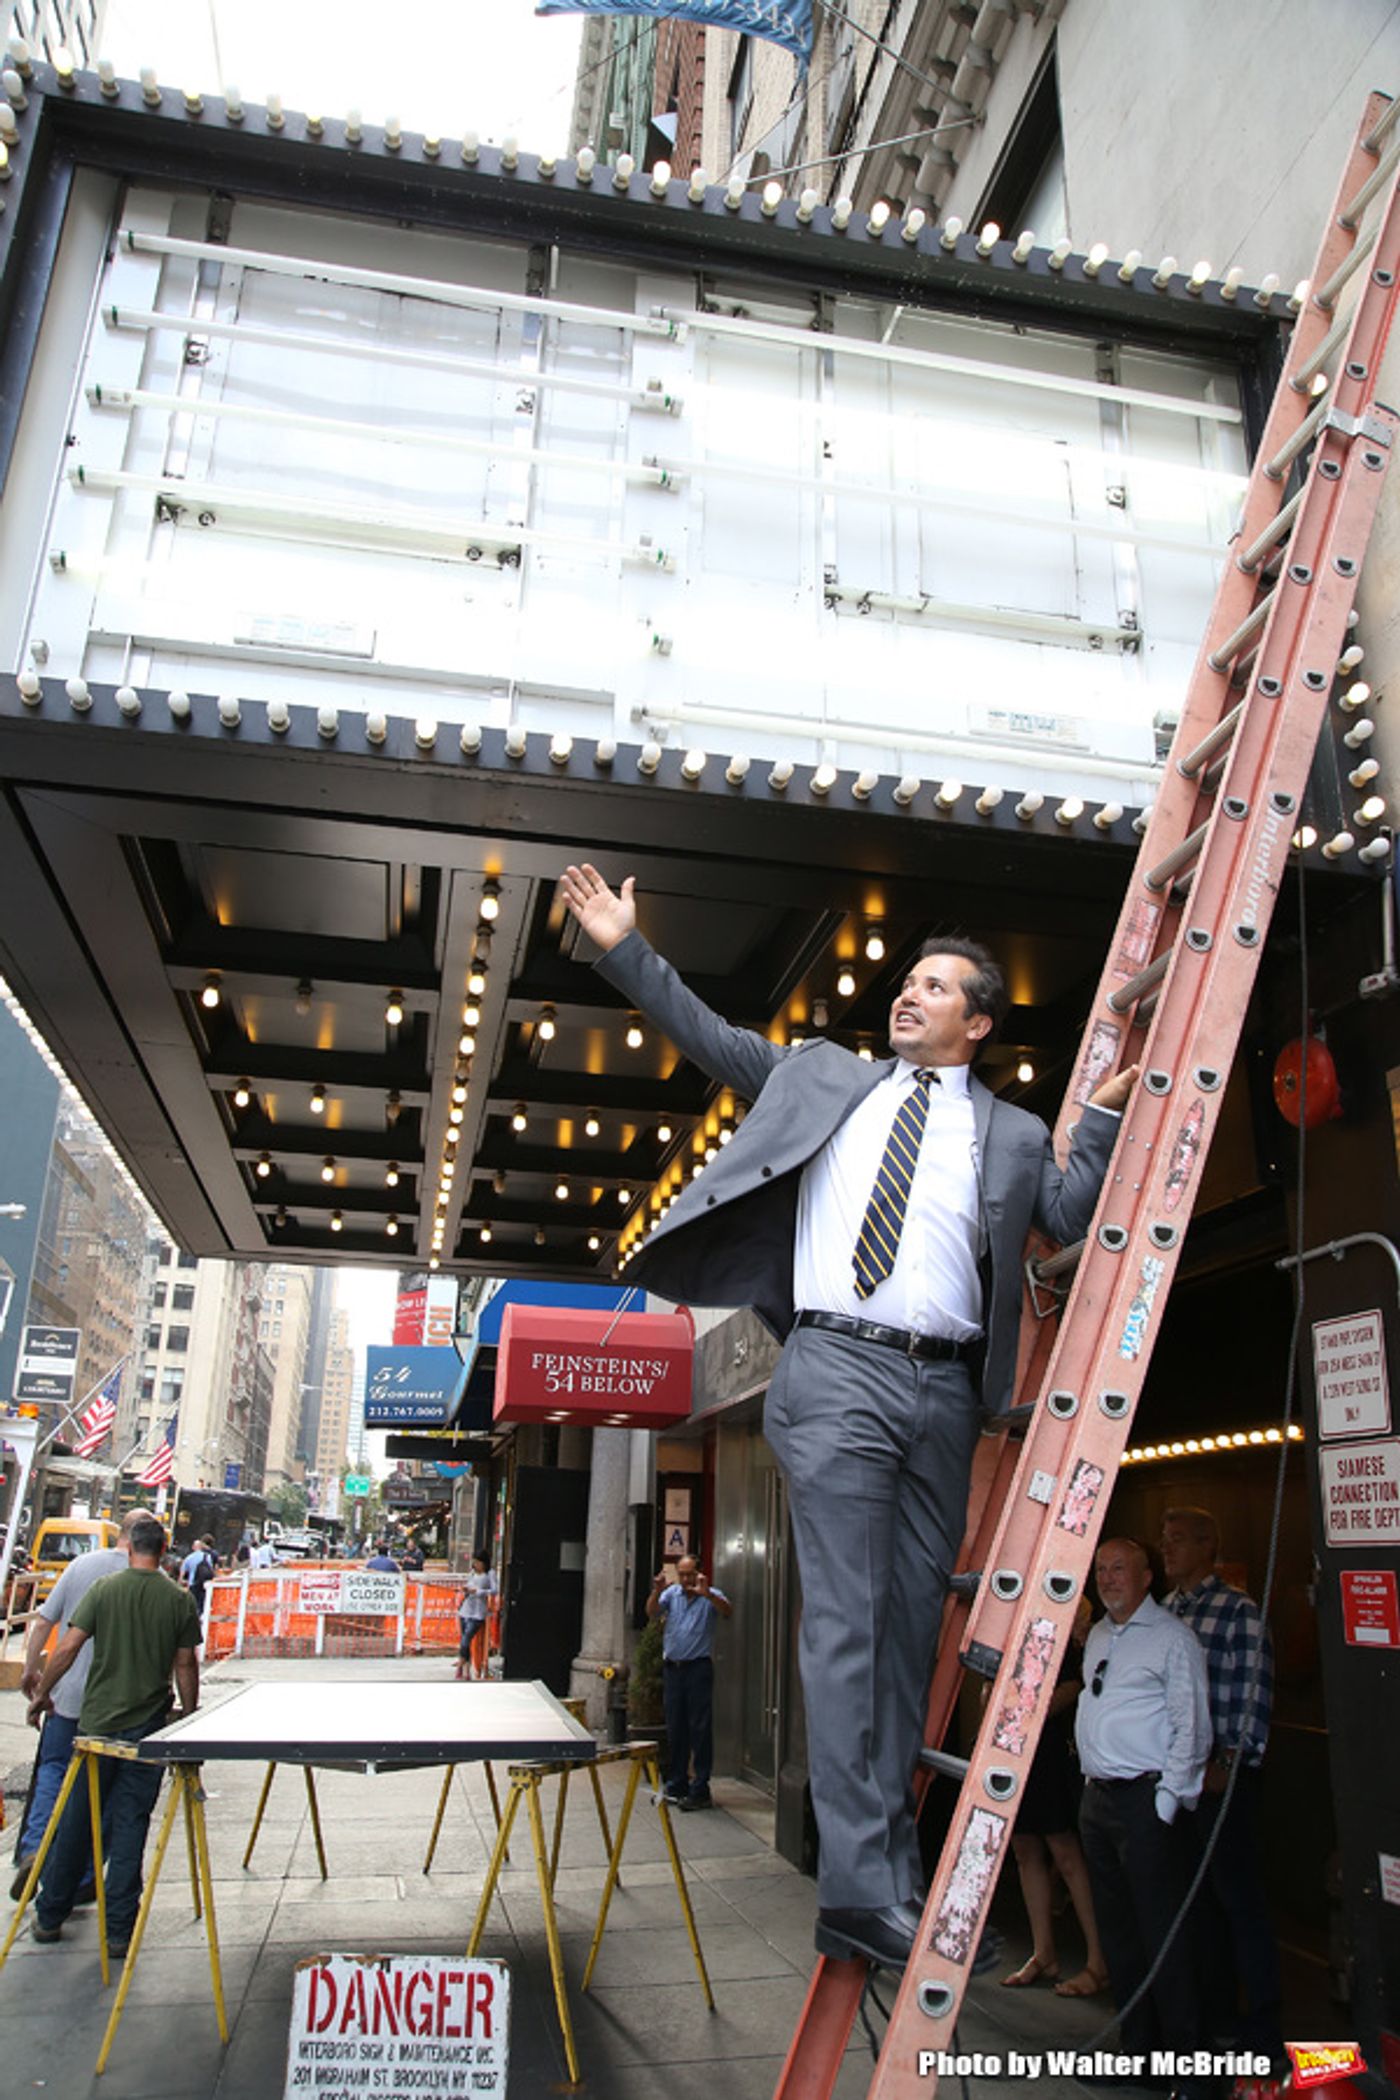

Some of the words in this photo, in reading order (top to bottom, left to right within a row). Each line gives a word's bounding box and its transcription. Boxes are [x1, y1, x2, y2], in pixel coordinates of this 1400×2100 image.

[373, 1365, 412, 1383] 54
[544, 1369, 575, 1393] 54
[580, 1375, 655, 1395] BELOW
[368, 1385, 443, 1400] Gourmet
[1337, 1455, 1386, 1478] SIAMESE
[1330, 1481, 1399, 1504] CONNECTION
[1330, 1510, 1348, 1530] FOR
[1351, 1509, 1371, 1529] FIRE
[669, 1528, 685, 1546] A
[301, 1591, 324, 1600] MEN
[350, 1588, 396, 1600] CLOSED
[303, 1603, 335, 1612] WORK
[306, 1966, 495, 2039] DANGER
